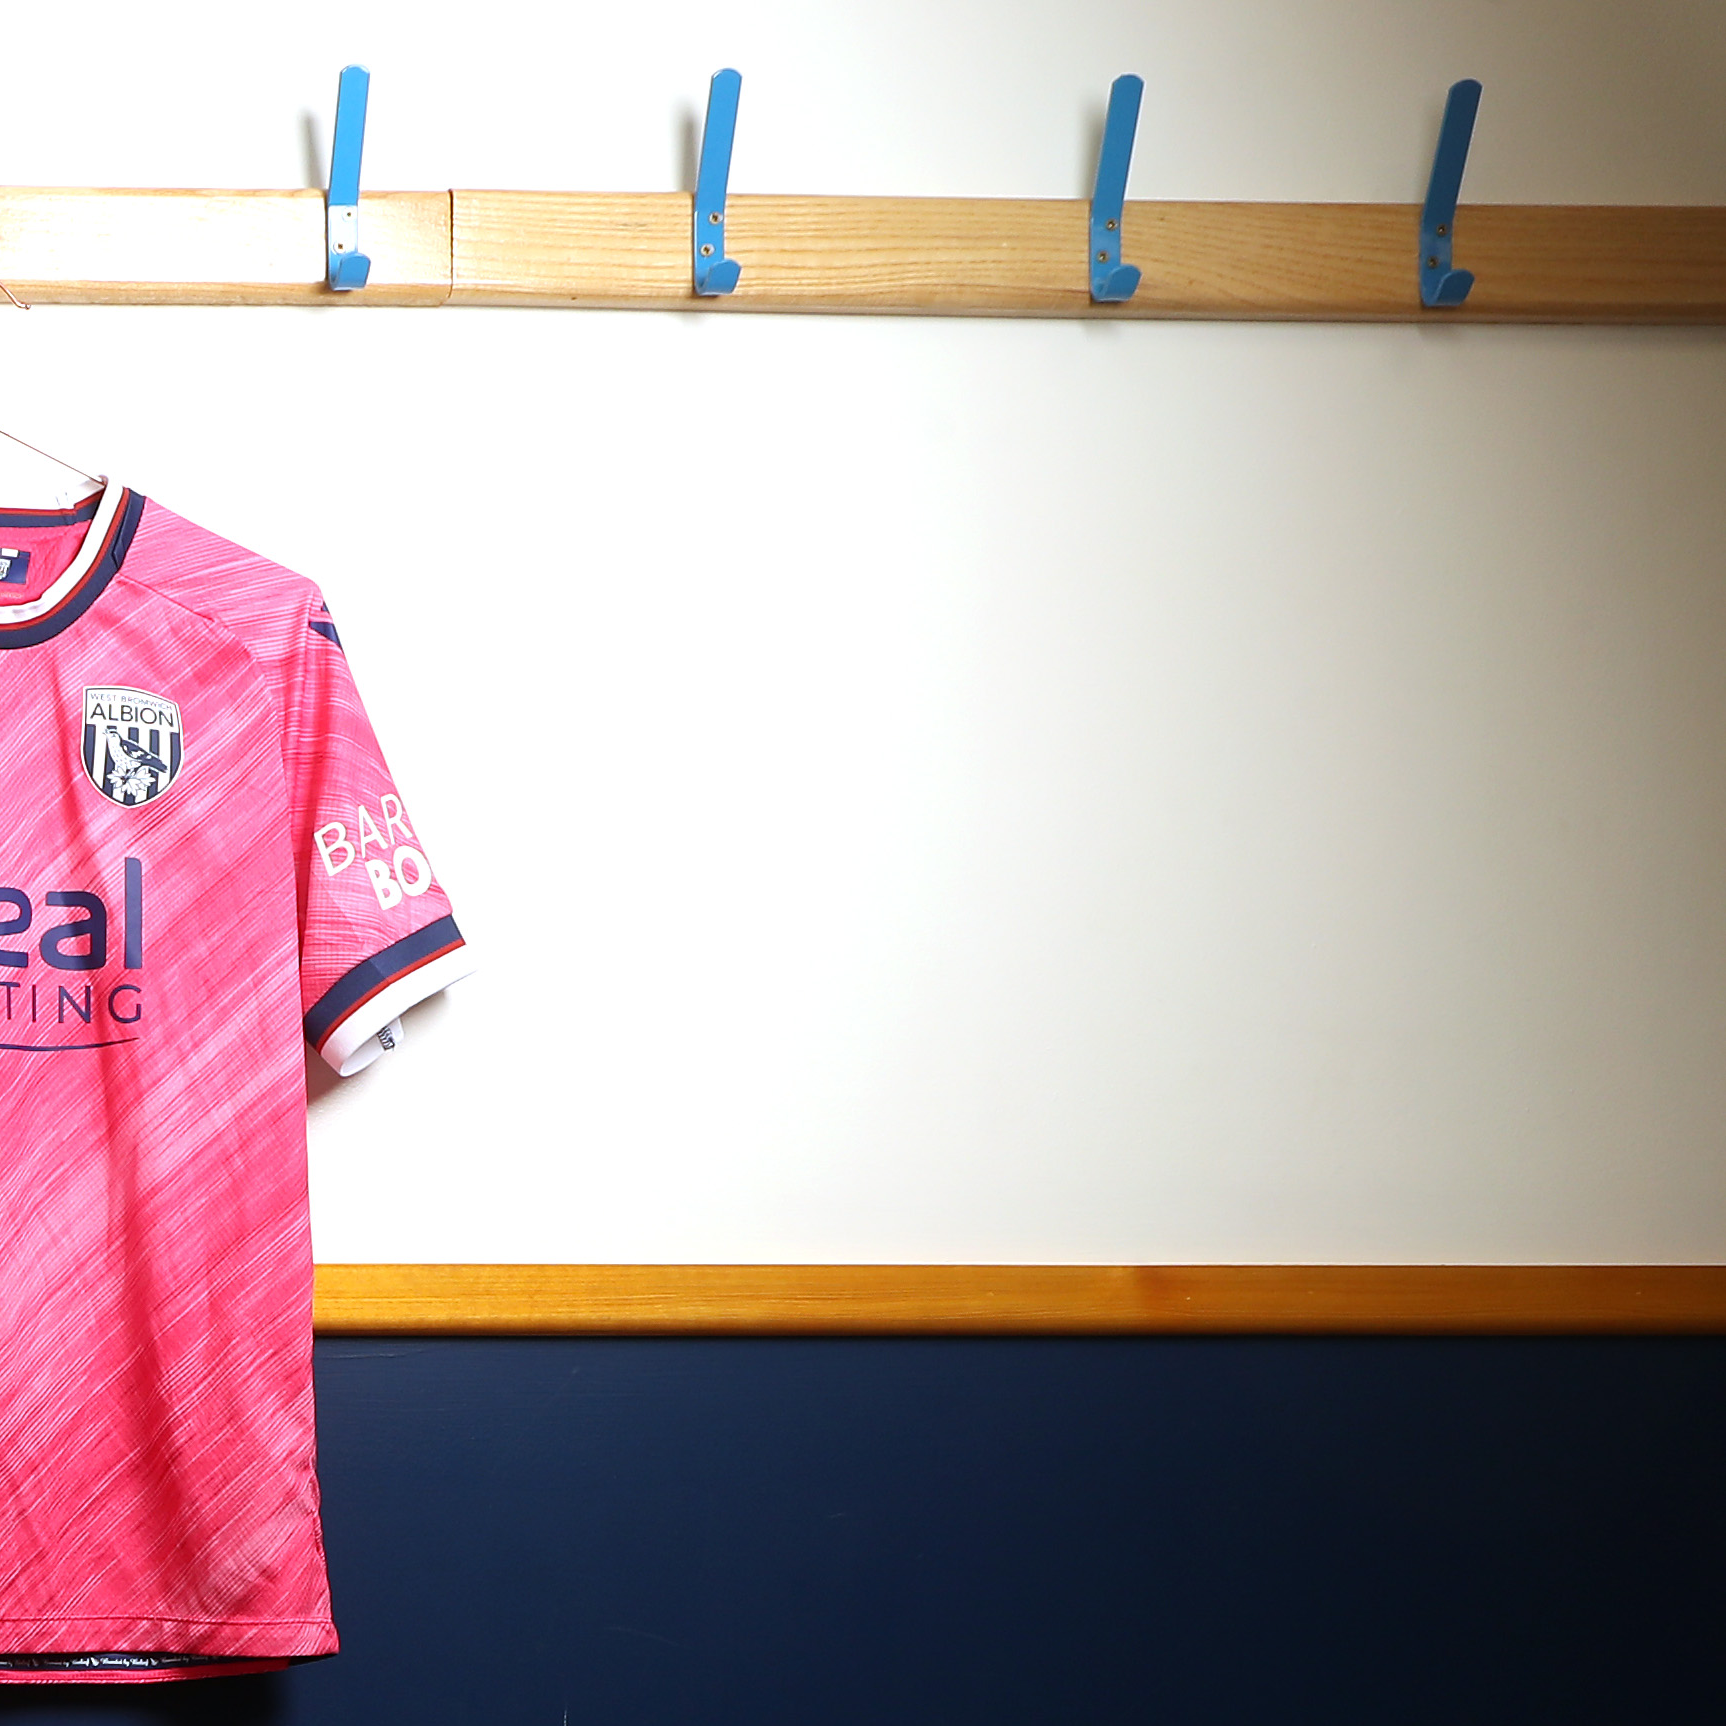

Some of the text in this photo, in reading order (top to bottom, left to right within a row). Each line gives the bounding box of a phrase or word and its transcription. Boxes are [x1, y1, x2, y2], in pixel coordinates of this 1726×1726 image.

[90, 693, 173, 710] WEST BROMWICH
[90, 702, 175, 727] ALBION
[314, 793, 414, 877] BAR
[364, 845, 432, 910] BO
